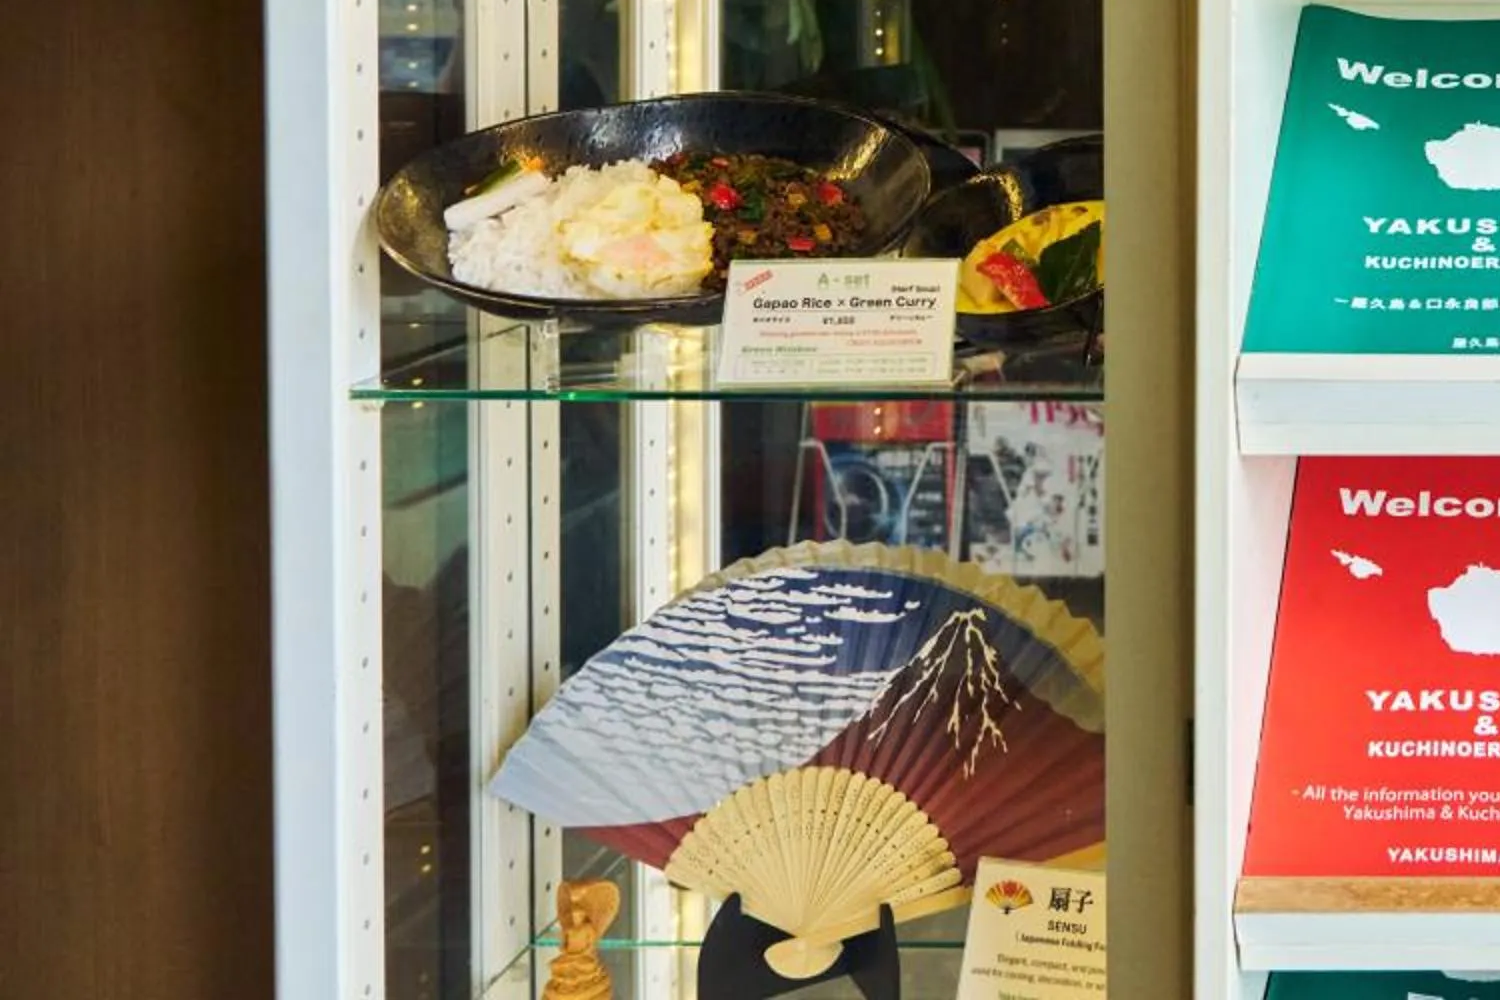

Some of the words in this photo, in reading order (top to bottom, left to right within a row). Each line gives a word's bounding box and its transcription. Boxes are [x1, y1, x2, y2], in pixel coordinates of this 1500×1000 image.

[1471, 237, 1496, 252] &
[817, 273, 830, 289] A
[844, 273, 871, 288] set
[753, 297, 798, 311] Gapao
[801, 297, 832, 309] Rice
[849, 296, 892, 309] Green
[895, 295, 937, 310] Curry
[1474, 716, 1498, 735] &
[1303, 785, 1325, 801] All
[1331, 786, 1359, 801] the
[1363, 786, 1464, 802] information
[1468, 790, 1500, 807] you
[1343, 804, 1436, 821] Yakushima
[1440, 806, 1453, 820] &
[1047, 886, 1094, 914] 扇子
[1047, 919, 1088, 935] SENSU
[1061, 936, 1093, 952] Folding
